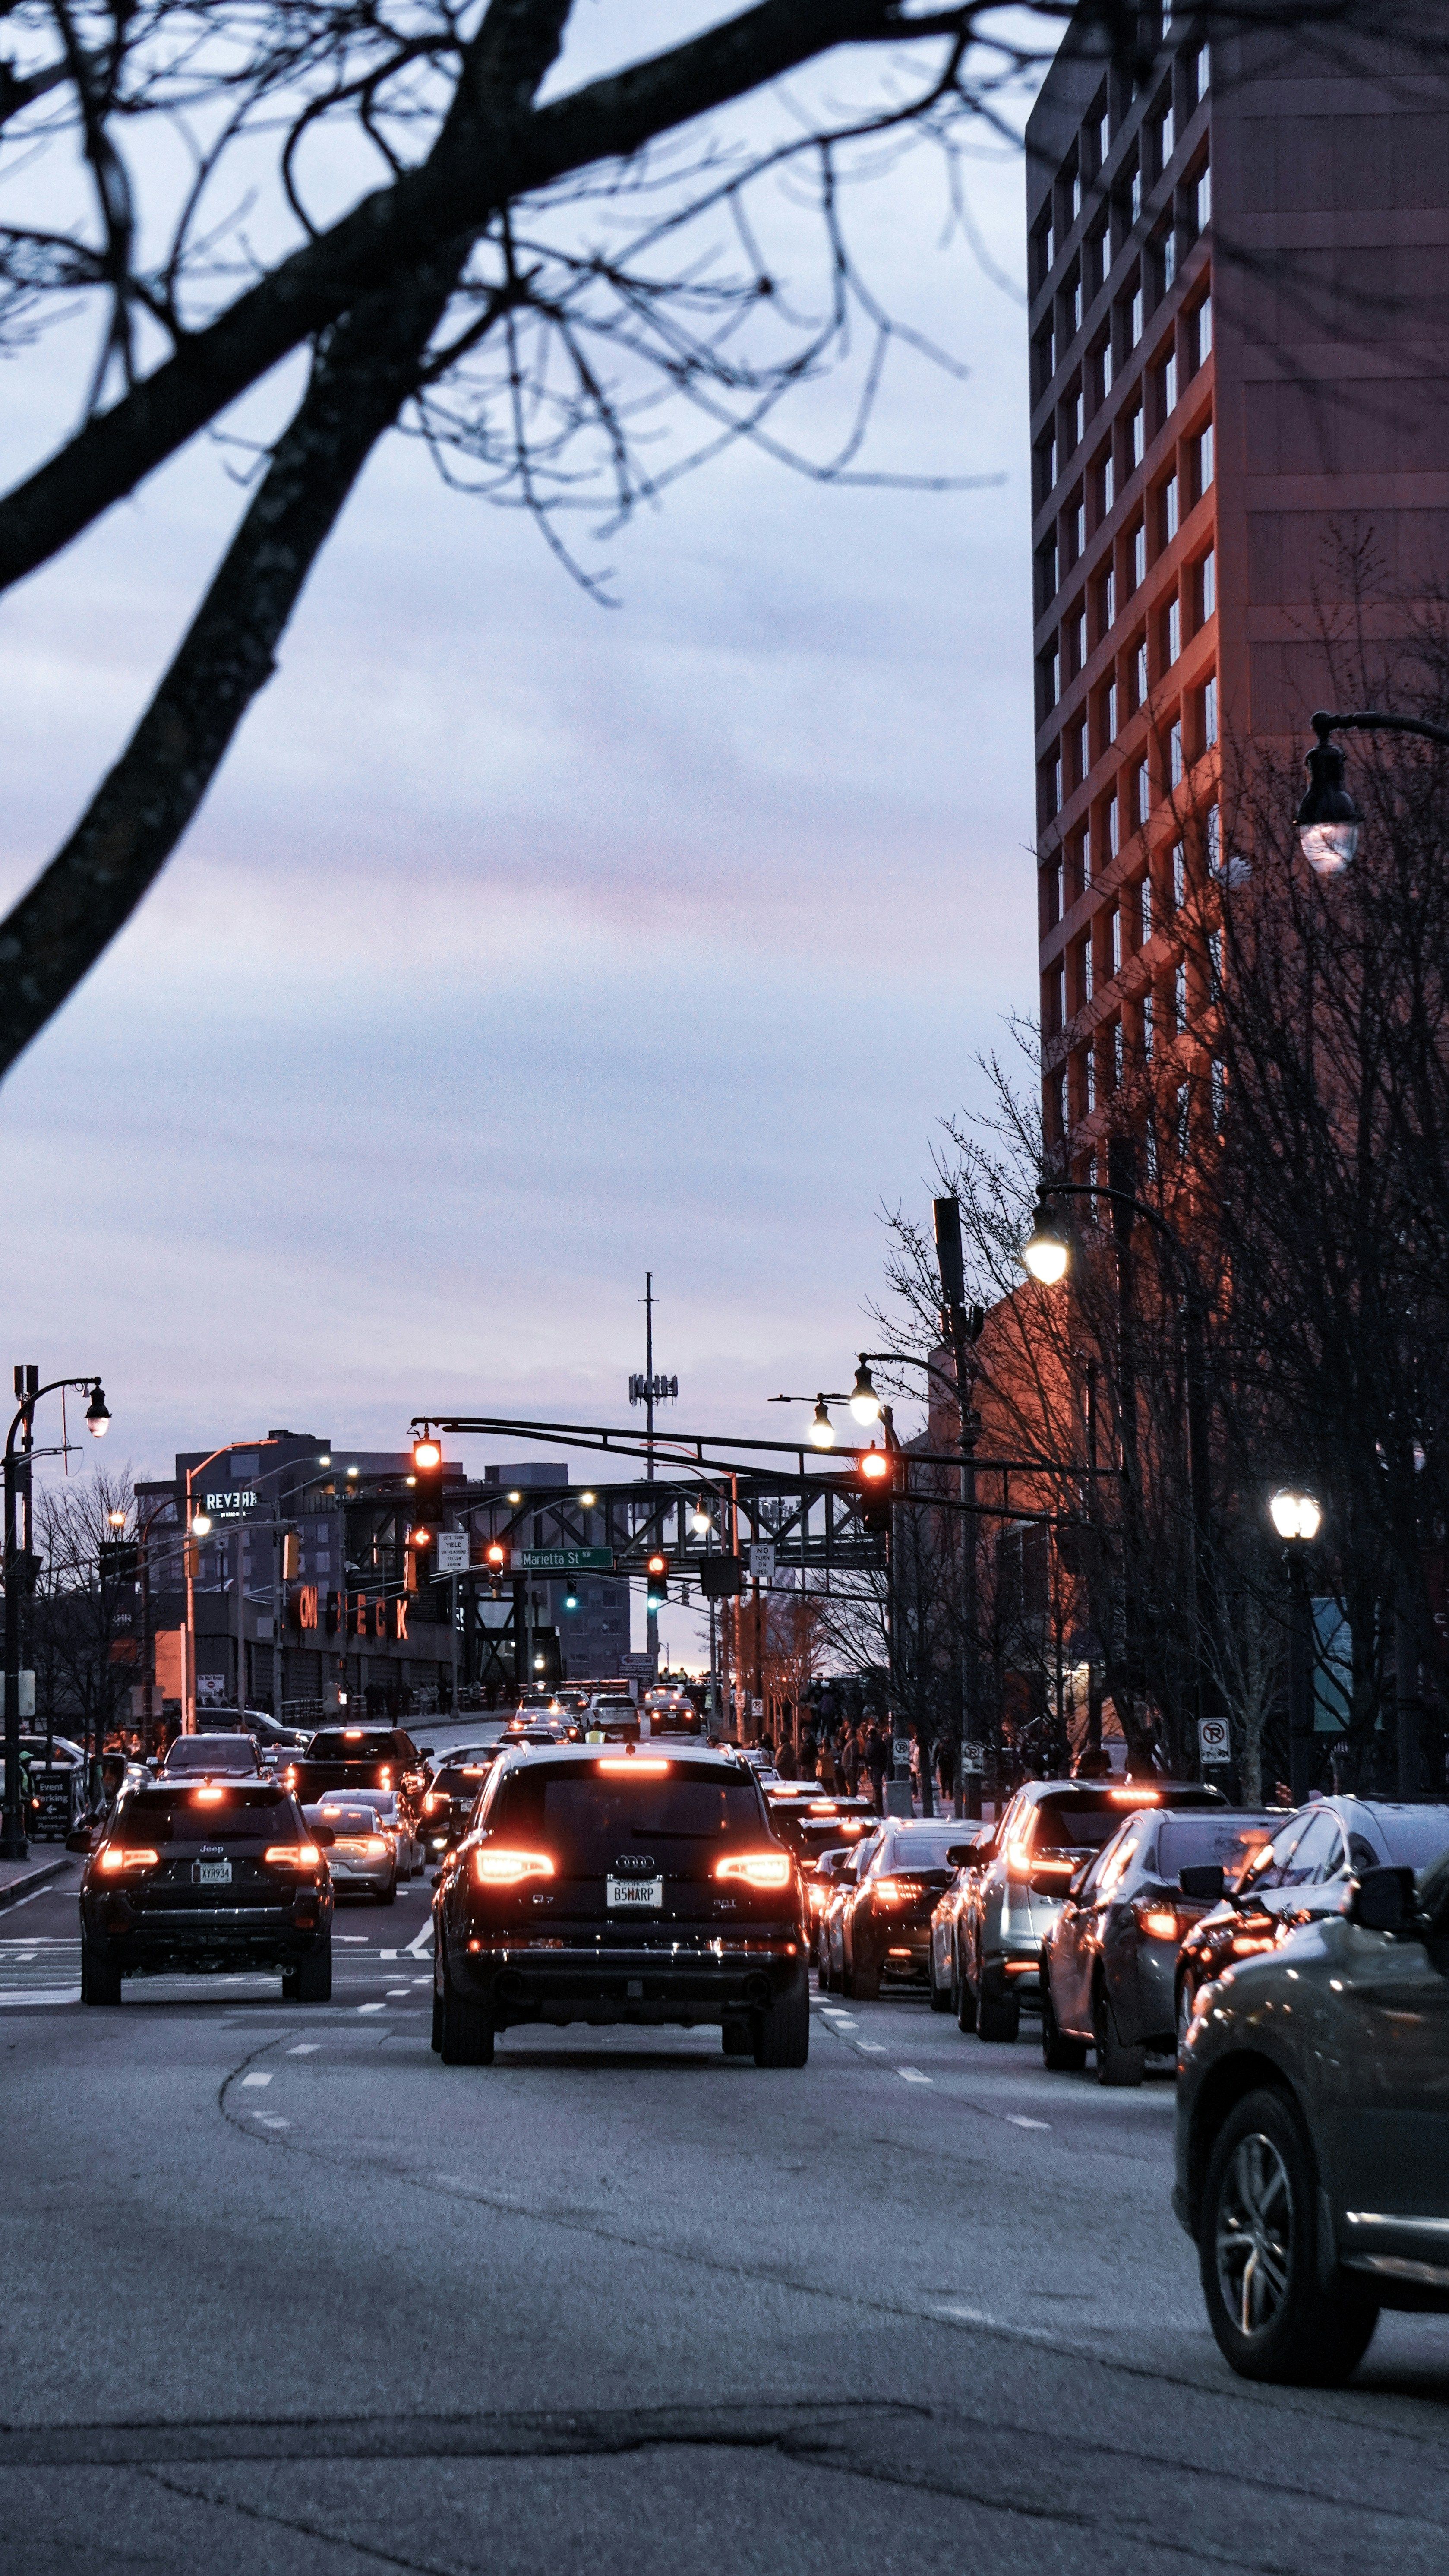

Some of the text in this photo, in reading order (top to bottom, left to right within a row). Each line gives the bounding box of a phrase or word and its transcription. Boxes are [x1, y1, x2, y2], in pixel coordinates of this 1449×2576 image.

[523, 1554, 564, 1565] Marietta
[568, 1552, 579, 1564] St
[39, 1783, 63, 1791] Event
[200, 1845, 224, 1854] Jeep
[202, 1869, 229, 1878] XYR934
[615, 1887, 653, 1901] B5HARP
